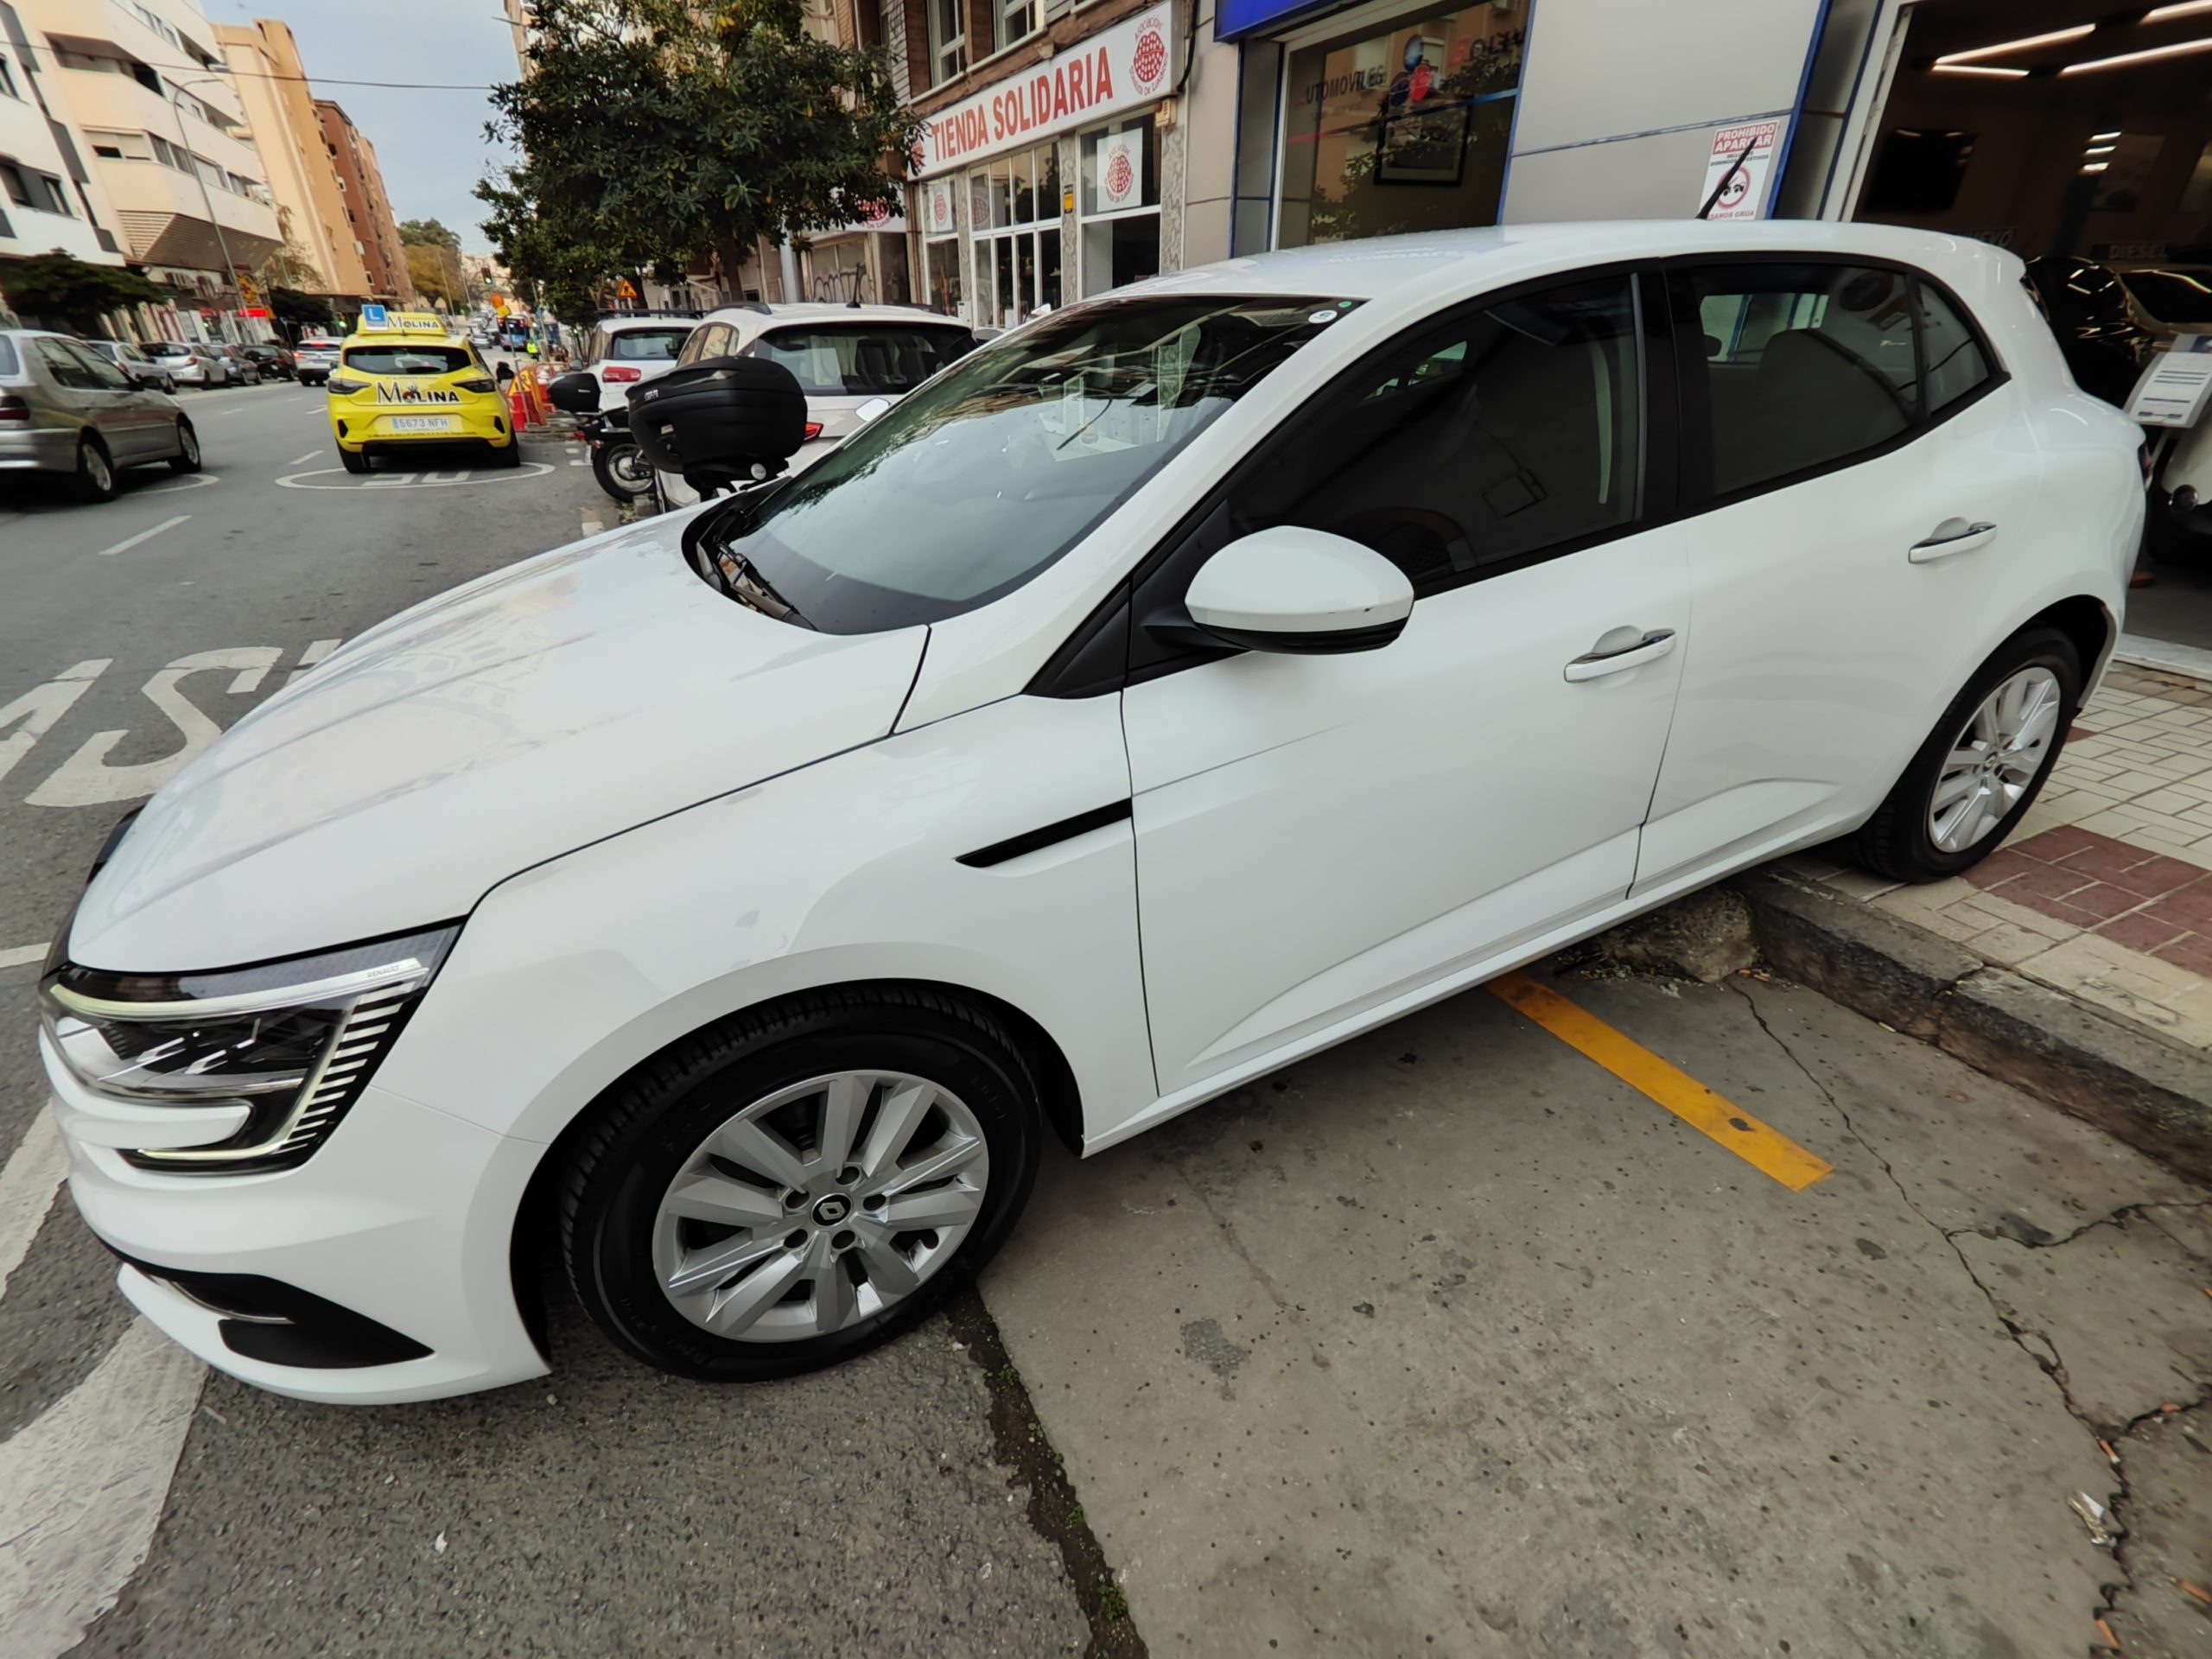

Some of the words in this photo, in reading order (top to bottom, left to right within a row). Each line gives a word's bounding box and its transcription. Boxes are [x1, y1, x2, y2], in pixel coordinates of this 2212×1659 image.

[931, 104, 989, 162] TIENDA
[993, 46, 1114, 142] SOLIDARIA
[1716, 124, 1776, 142] PROHIBIDO
[368, 307, 381, 320] L
[387, 315, 439, 328] MOLINA
[377, 381, 460, 404] MOLINA
[399, 418, 426, 429] 5673
